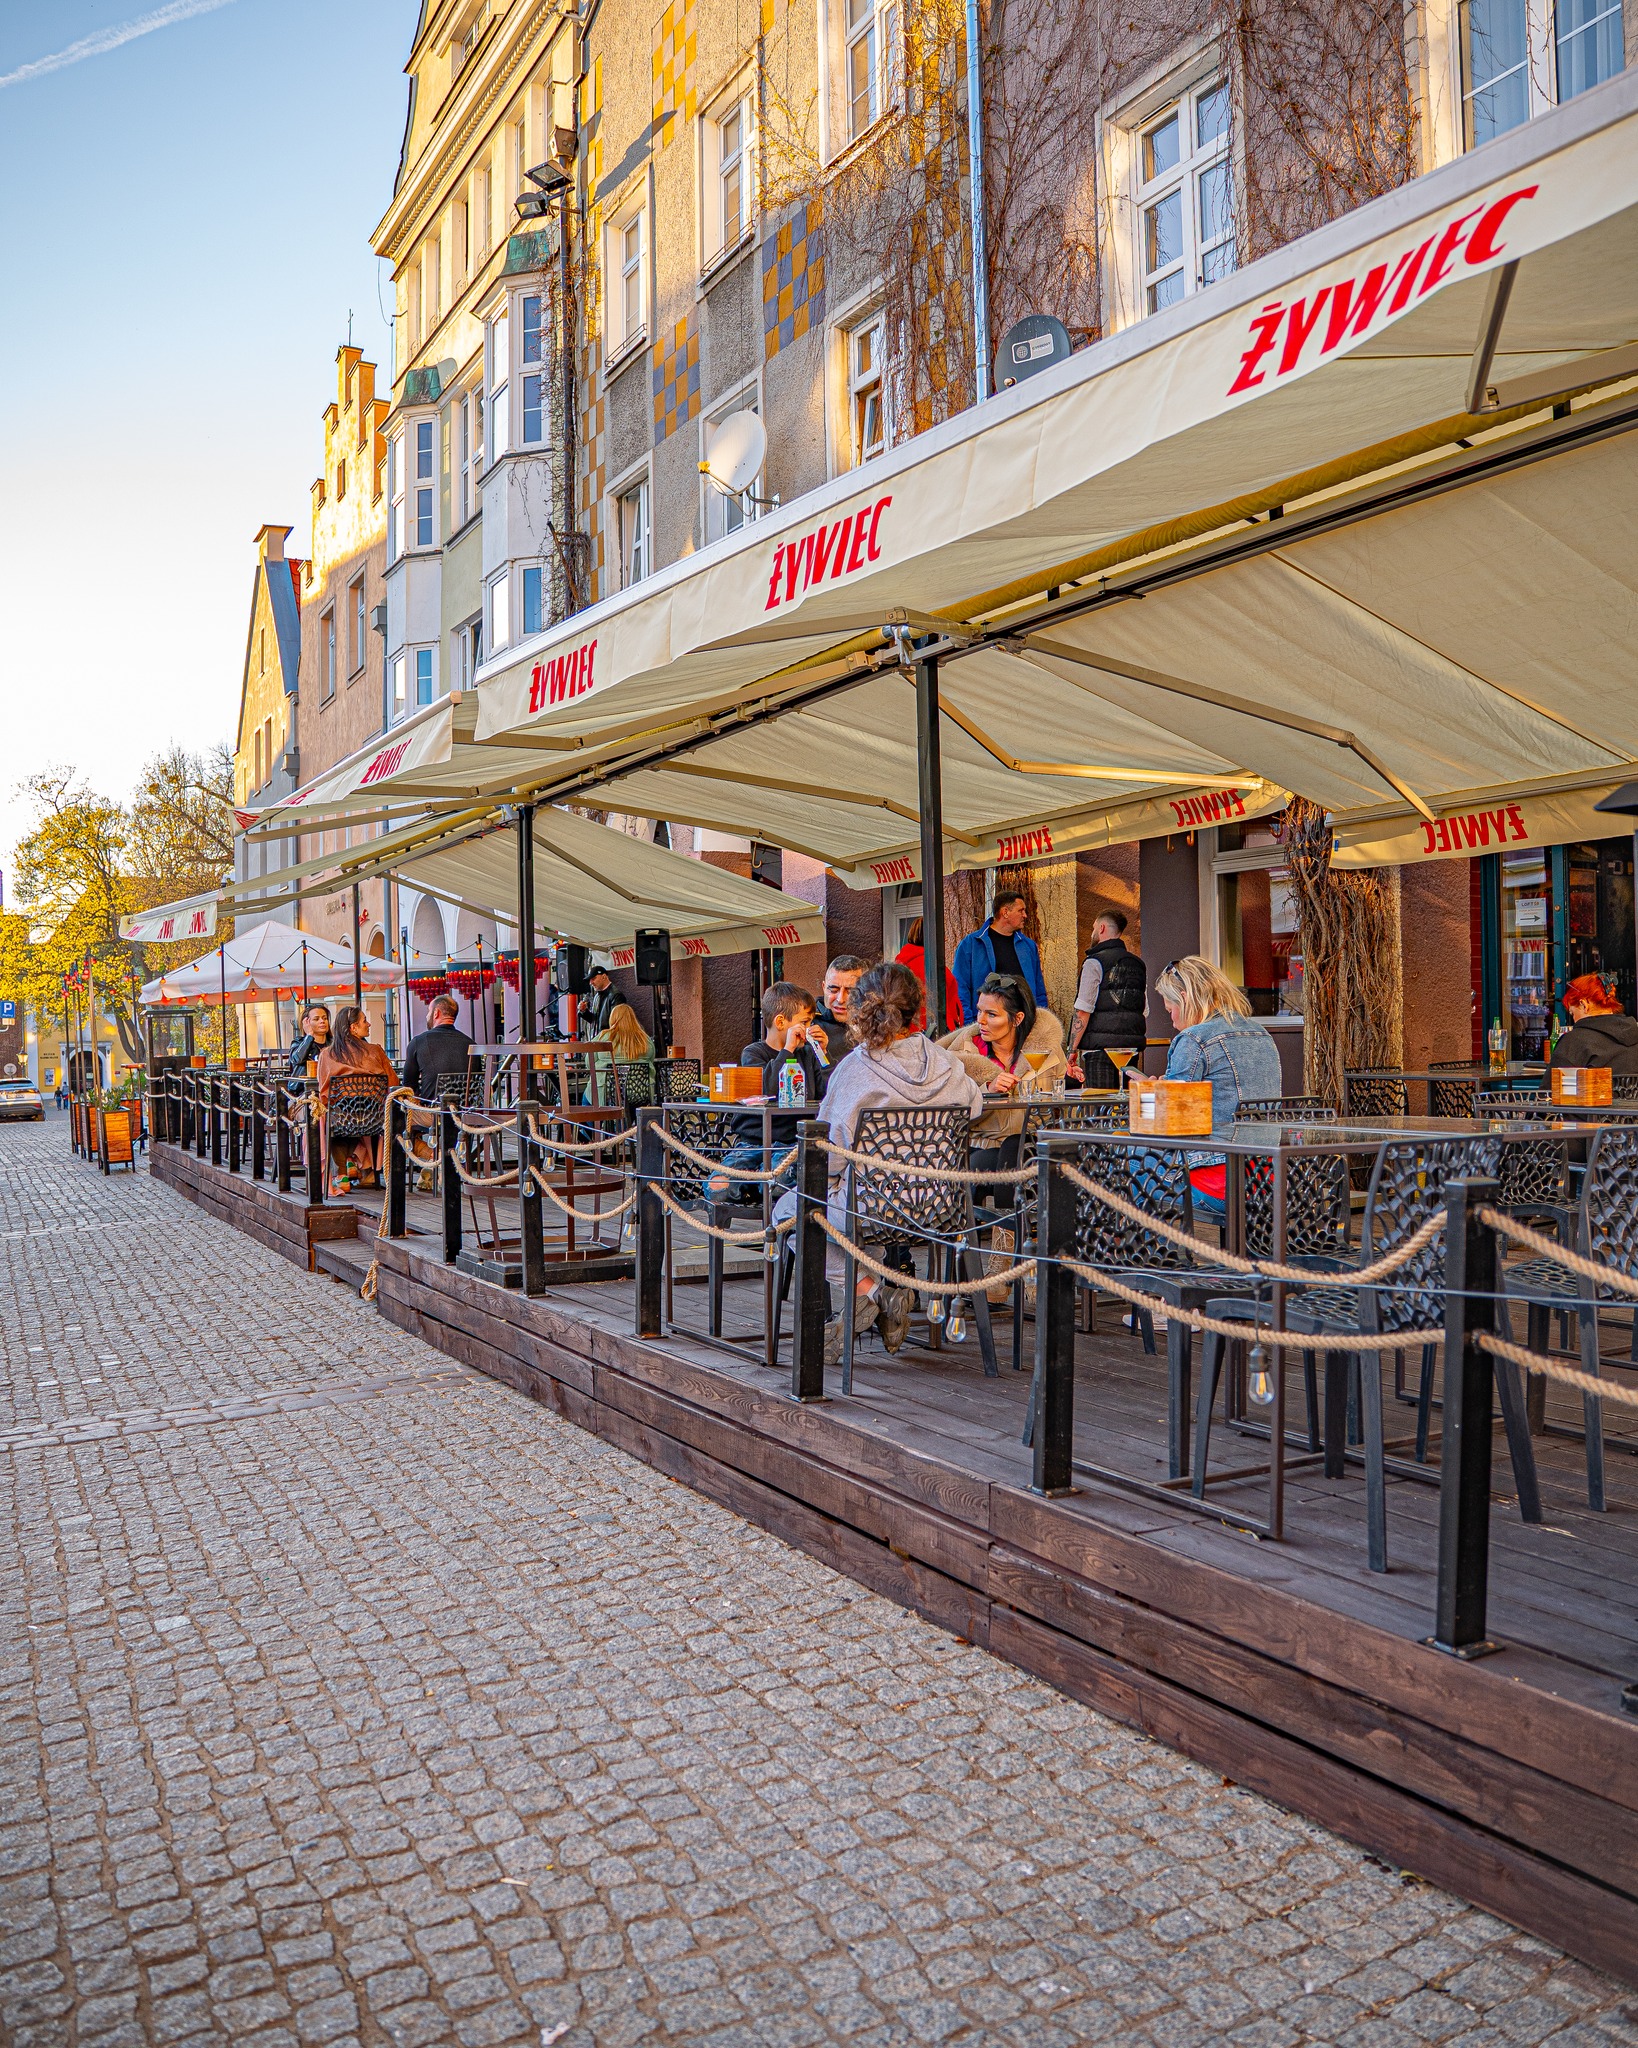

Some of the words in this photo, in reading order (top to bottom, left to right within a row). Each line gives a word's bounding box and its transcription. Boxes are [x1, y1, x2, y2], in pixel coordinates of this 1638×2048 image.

[1228, 184, 1540, 396] ŻYWIEC
[764, 496, 893, 611] ŻYWIEC
[529, 639, 598, 713] ŻYWIEC
